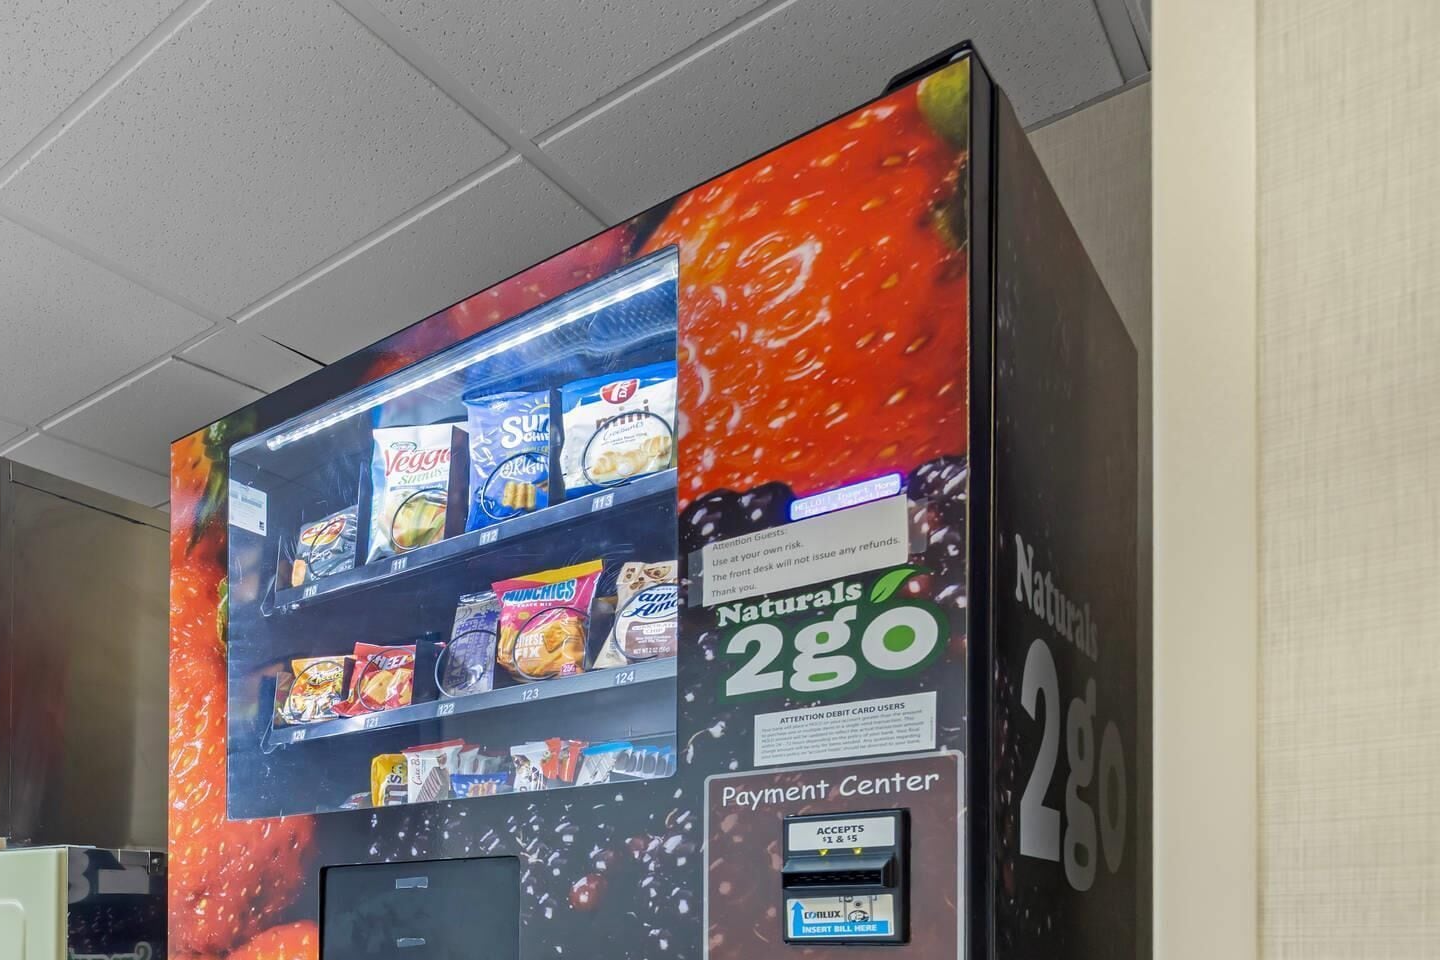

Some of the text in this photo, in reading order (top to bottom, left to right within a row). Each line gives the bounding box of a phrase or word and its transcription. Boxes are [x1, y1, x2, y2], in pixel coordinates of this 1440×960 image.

[712, 527, 788, 552] Attention Guests:
[712, 541, 804, 567] Use at your own risk.
[712, 536, 901, 582] The front desk will not issue any refunds.
[711, 582, 757, 598] Thank you.
[1015, 533, 1097, 662] Naturals
[718, 580, 862, 628] Naturals
[725, 604, 939, 697] 2go
[616, 671, 635, 684] 124
[522, 688, 540, 701] 123
[439, 703, 456, 715] 122
[779, 702, 905, 724] ATTENTION DEBIT CARD USERS
[1020, 638, 1127, 892] 2go
[722, 772, 940, 811] Payment Center
[817, 825, 865, 835] ACCEPTS
[822, 834, 858, 844] $1 & $5
[802, 924, 878, 934] INSERT BILL HERE
